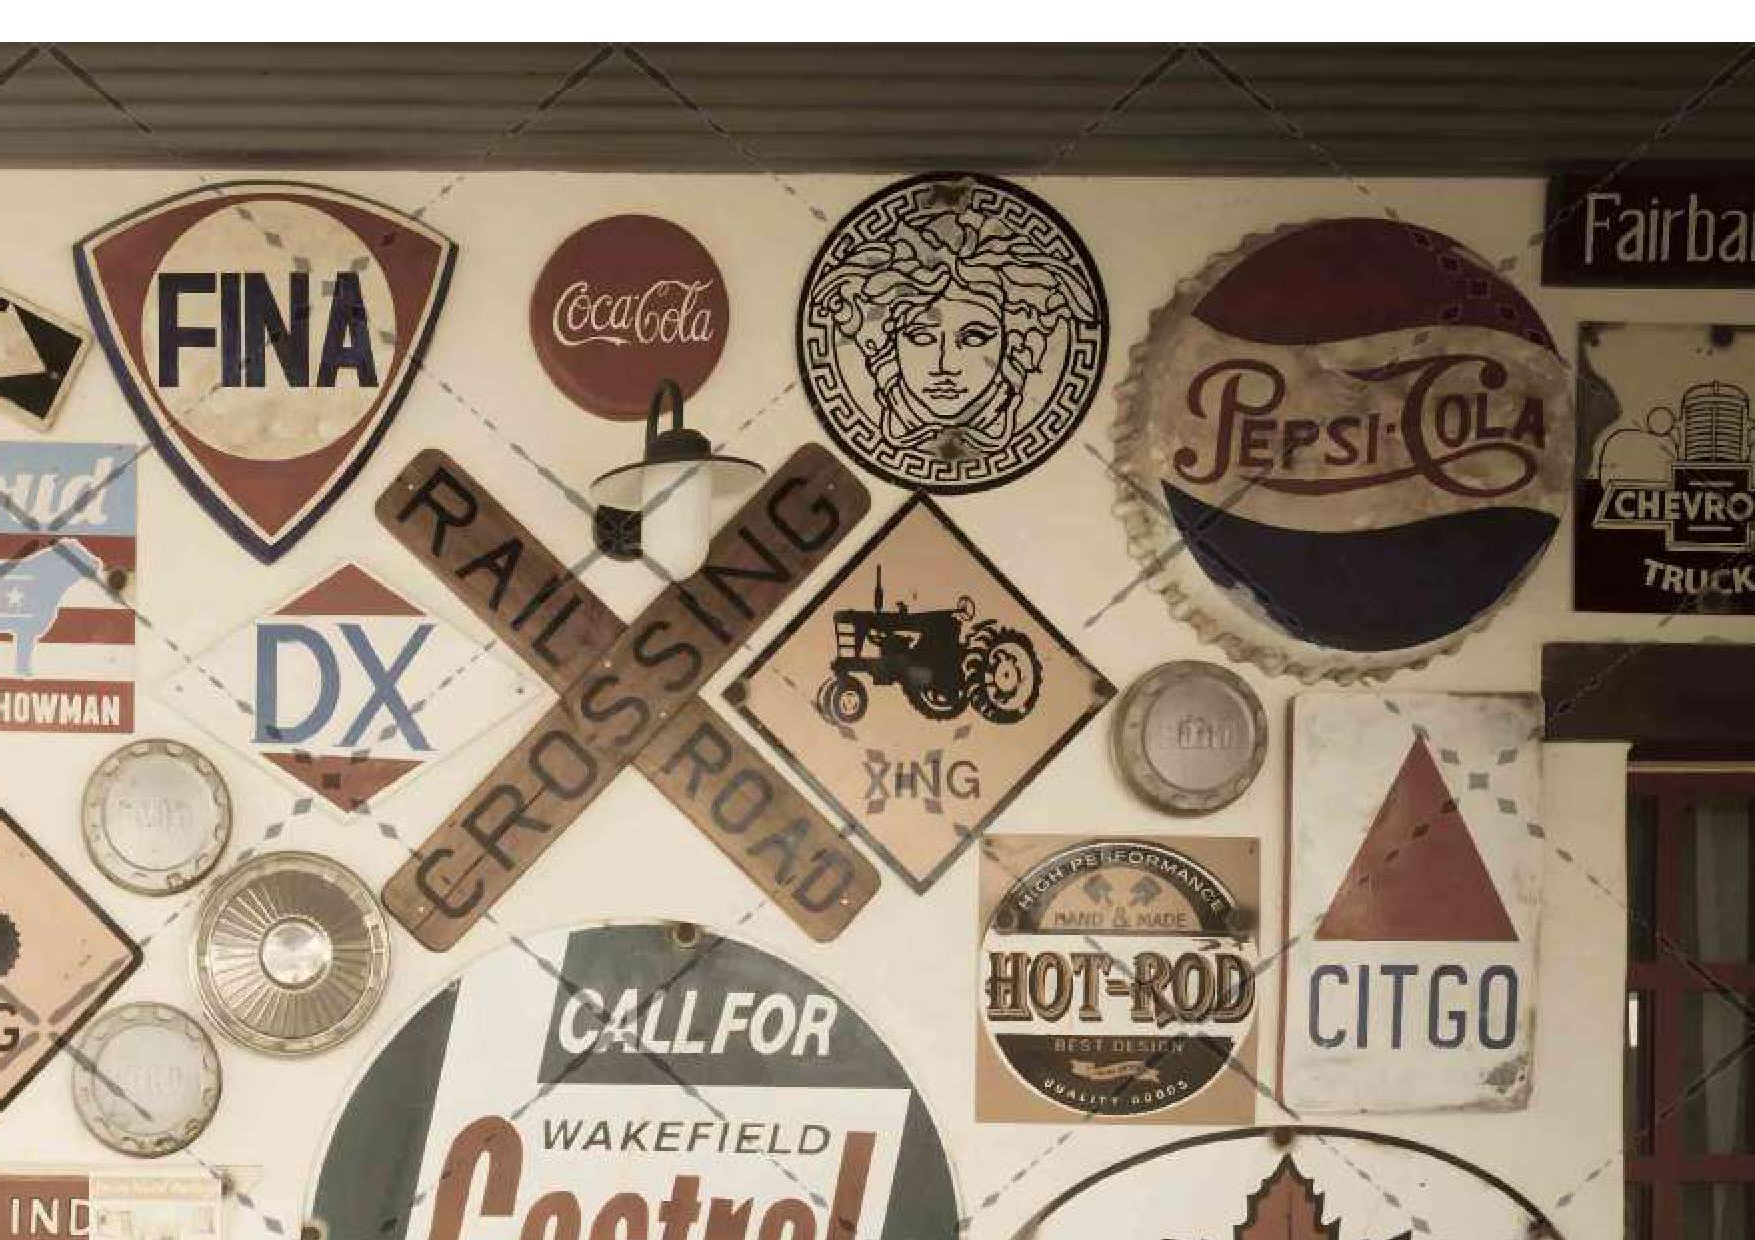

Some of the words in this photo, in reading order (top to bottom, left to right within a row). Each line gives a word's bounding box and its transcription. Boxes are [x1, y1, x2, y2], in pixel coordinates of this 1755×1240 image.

[1584, 192, 1755, 265] Fairba
[158, 272, 380, 389] FINA
[249, 622, 439, 752] DX
[397, 466, 584, 668] RAIL
[660, 720, 858, 915] ROAD
[415, 475, 842, 922] CROSSING
[862, 759, 981, 800] XING
[985, 952, 1256, 1029] HOT-ROD
[1308, 963, 1518, 1050] CITGO
[542, 1118, 833, 1156] WAKEFIELD
